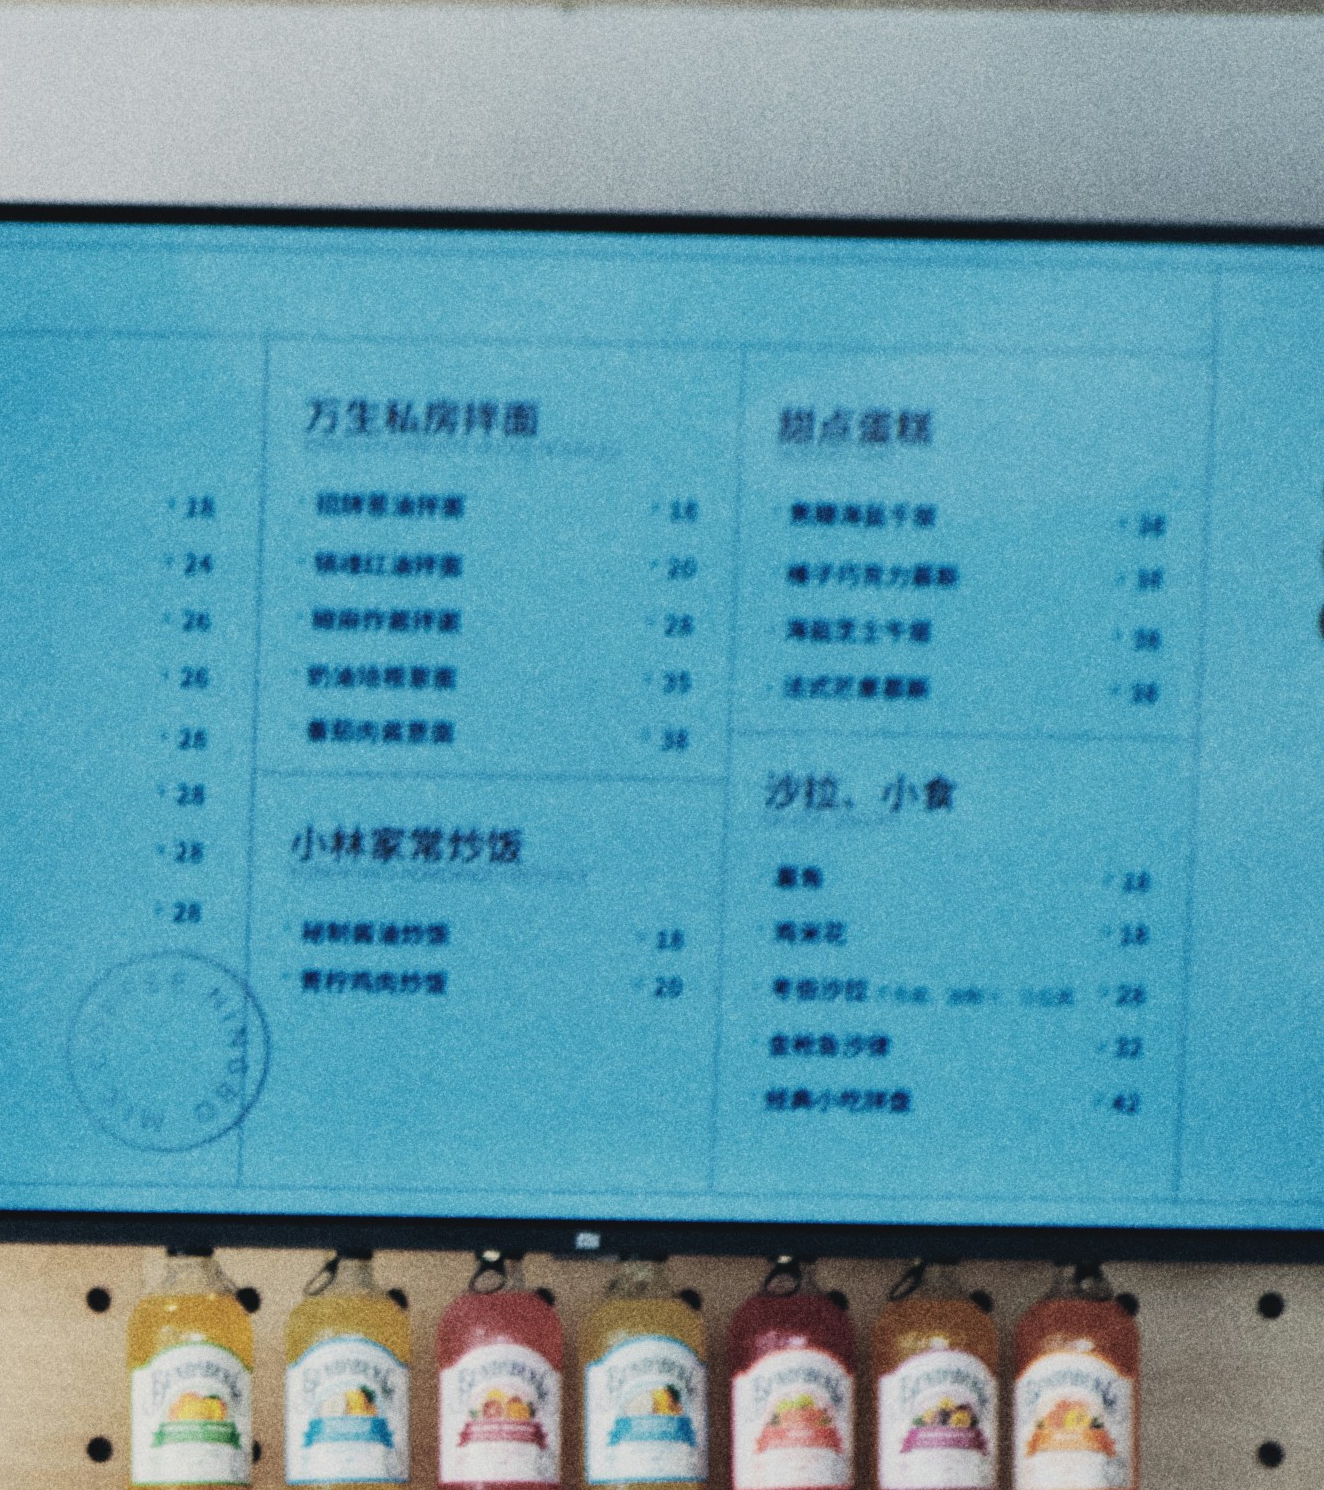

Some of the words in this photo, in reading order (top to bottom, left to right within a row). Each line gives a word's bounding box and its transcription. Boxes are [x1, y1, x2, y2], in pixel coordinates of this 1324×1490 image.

[292, 826, 522, 863] 小林家常炒饭
